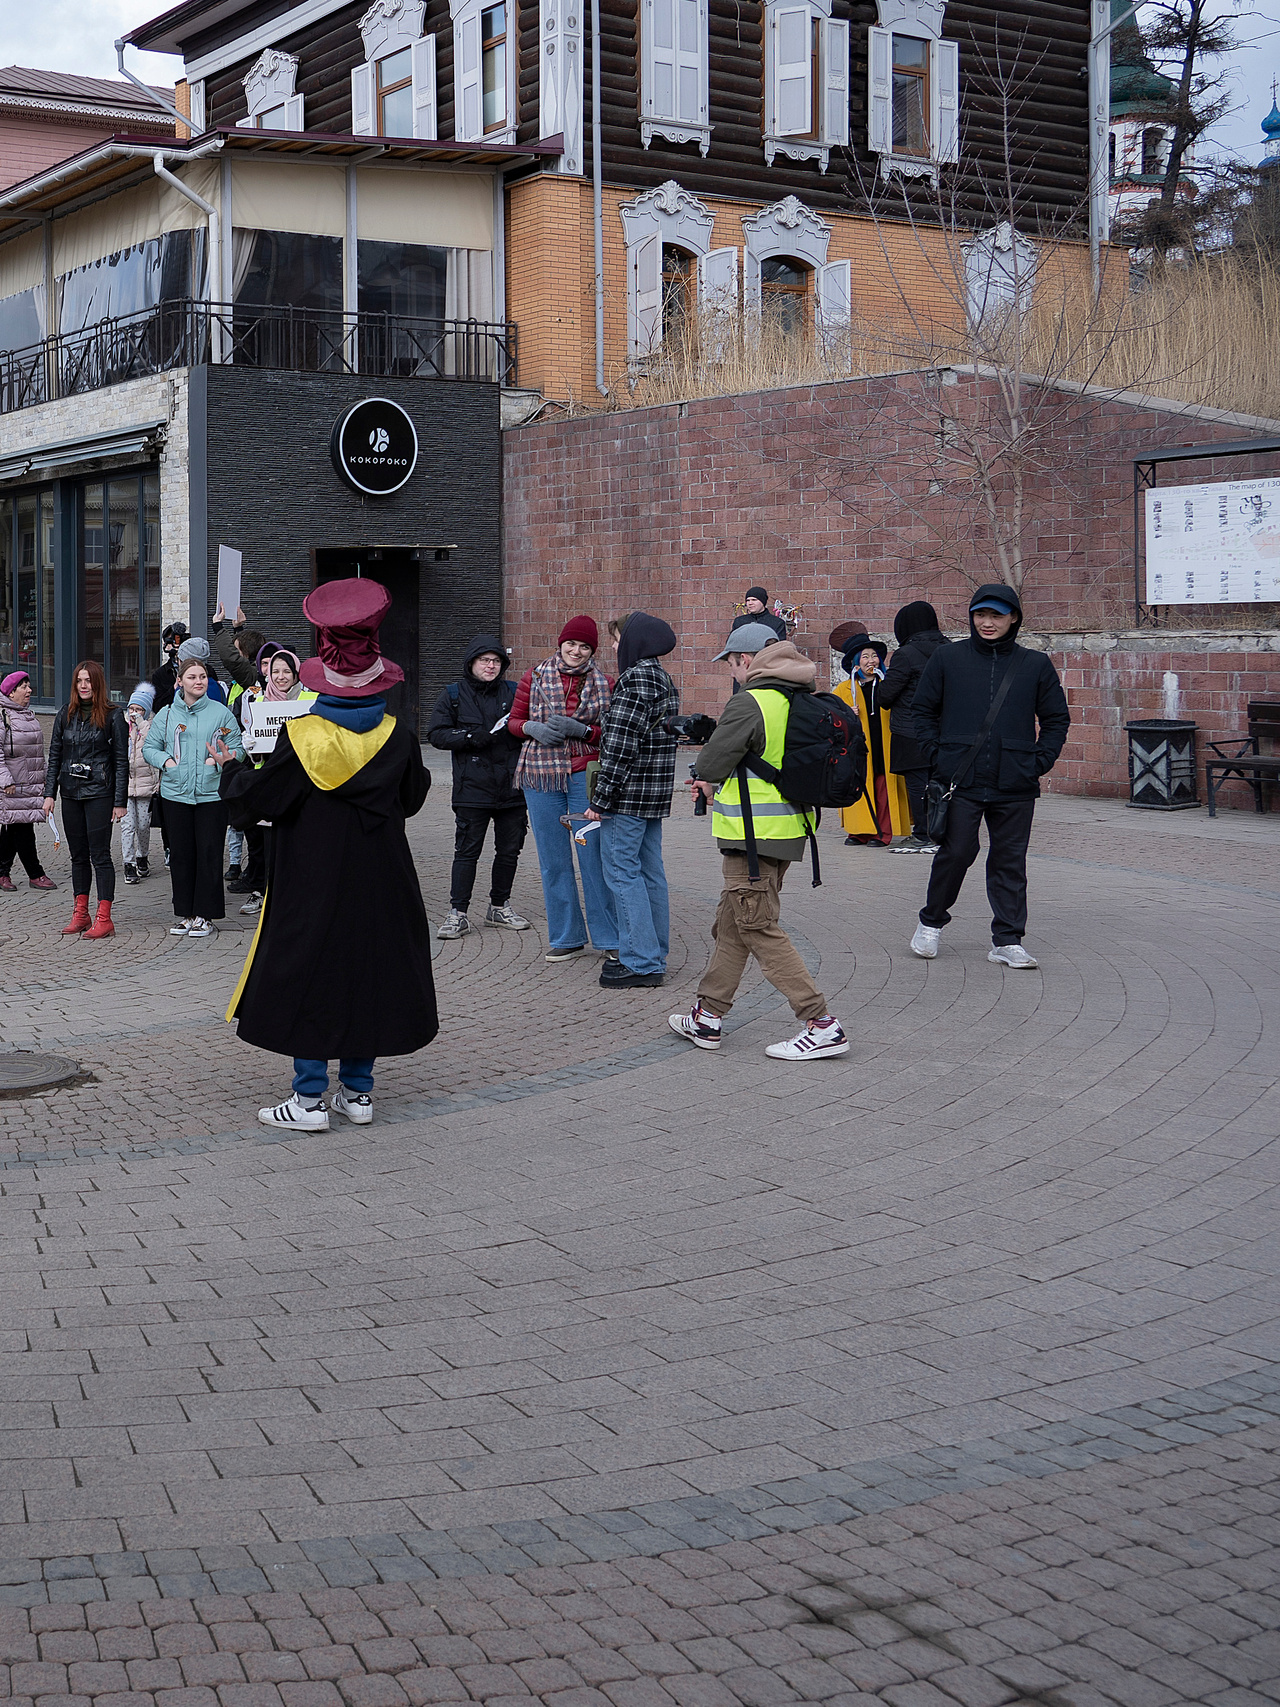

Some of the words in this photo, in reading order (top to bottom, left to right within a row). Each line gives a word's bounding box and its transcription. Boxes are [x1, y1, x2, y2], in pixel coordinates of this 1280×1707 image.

[1228, 483, 1240, 491] The
[1241, 482, 1256, 490] map
[254, 728, 280, 738] ВАШЕ
